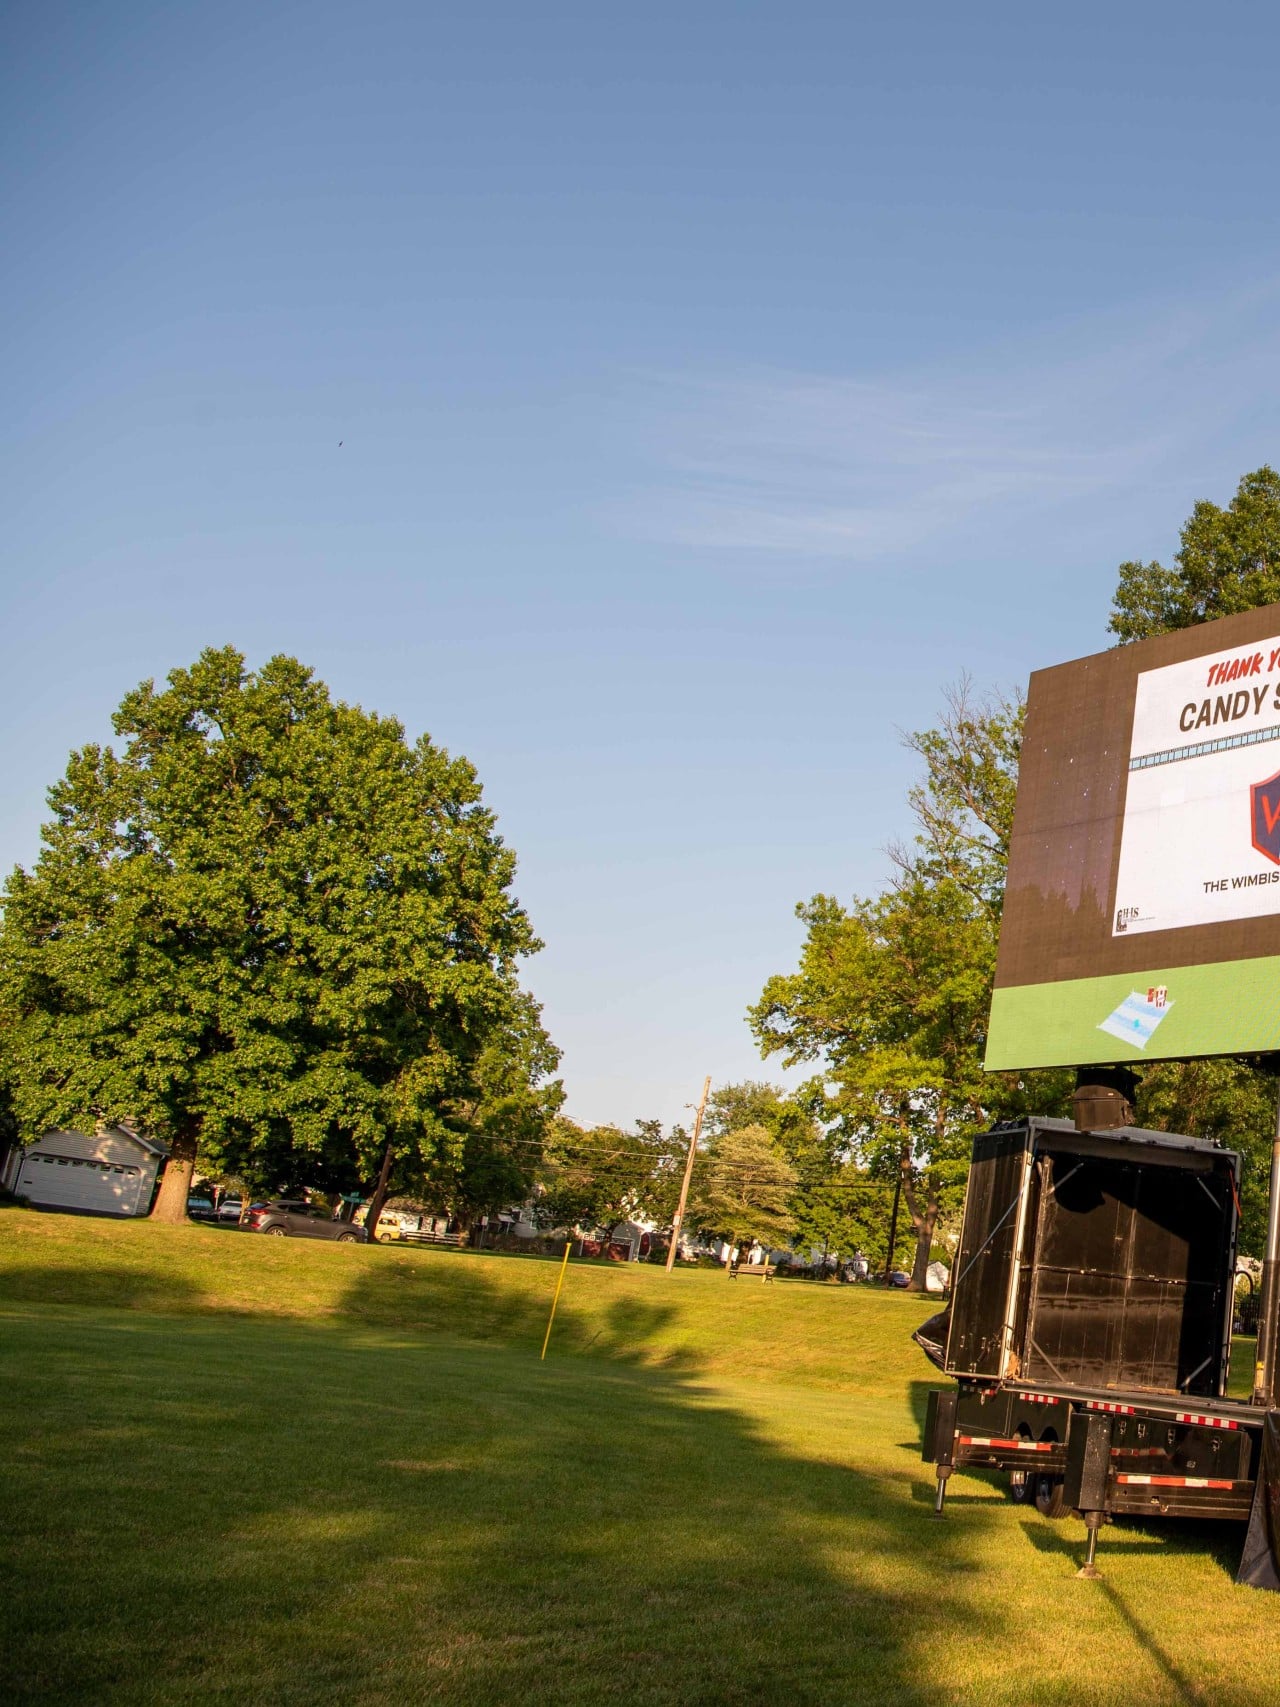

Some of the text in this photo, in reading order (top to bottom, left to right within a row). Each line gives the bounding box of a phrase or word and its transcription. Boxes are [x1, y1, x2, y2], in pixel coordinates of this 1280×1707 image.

[1207, 652, 1264, 687] THANK
[1179, 684, 1269, 732] CANDY
[1203, 879, 1228, 893] THE
